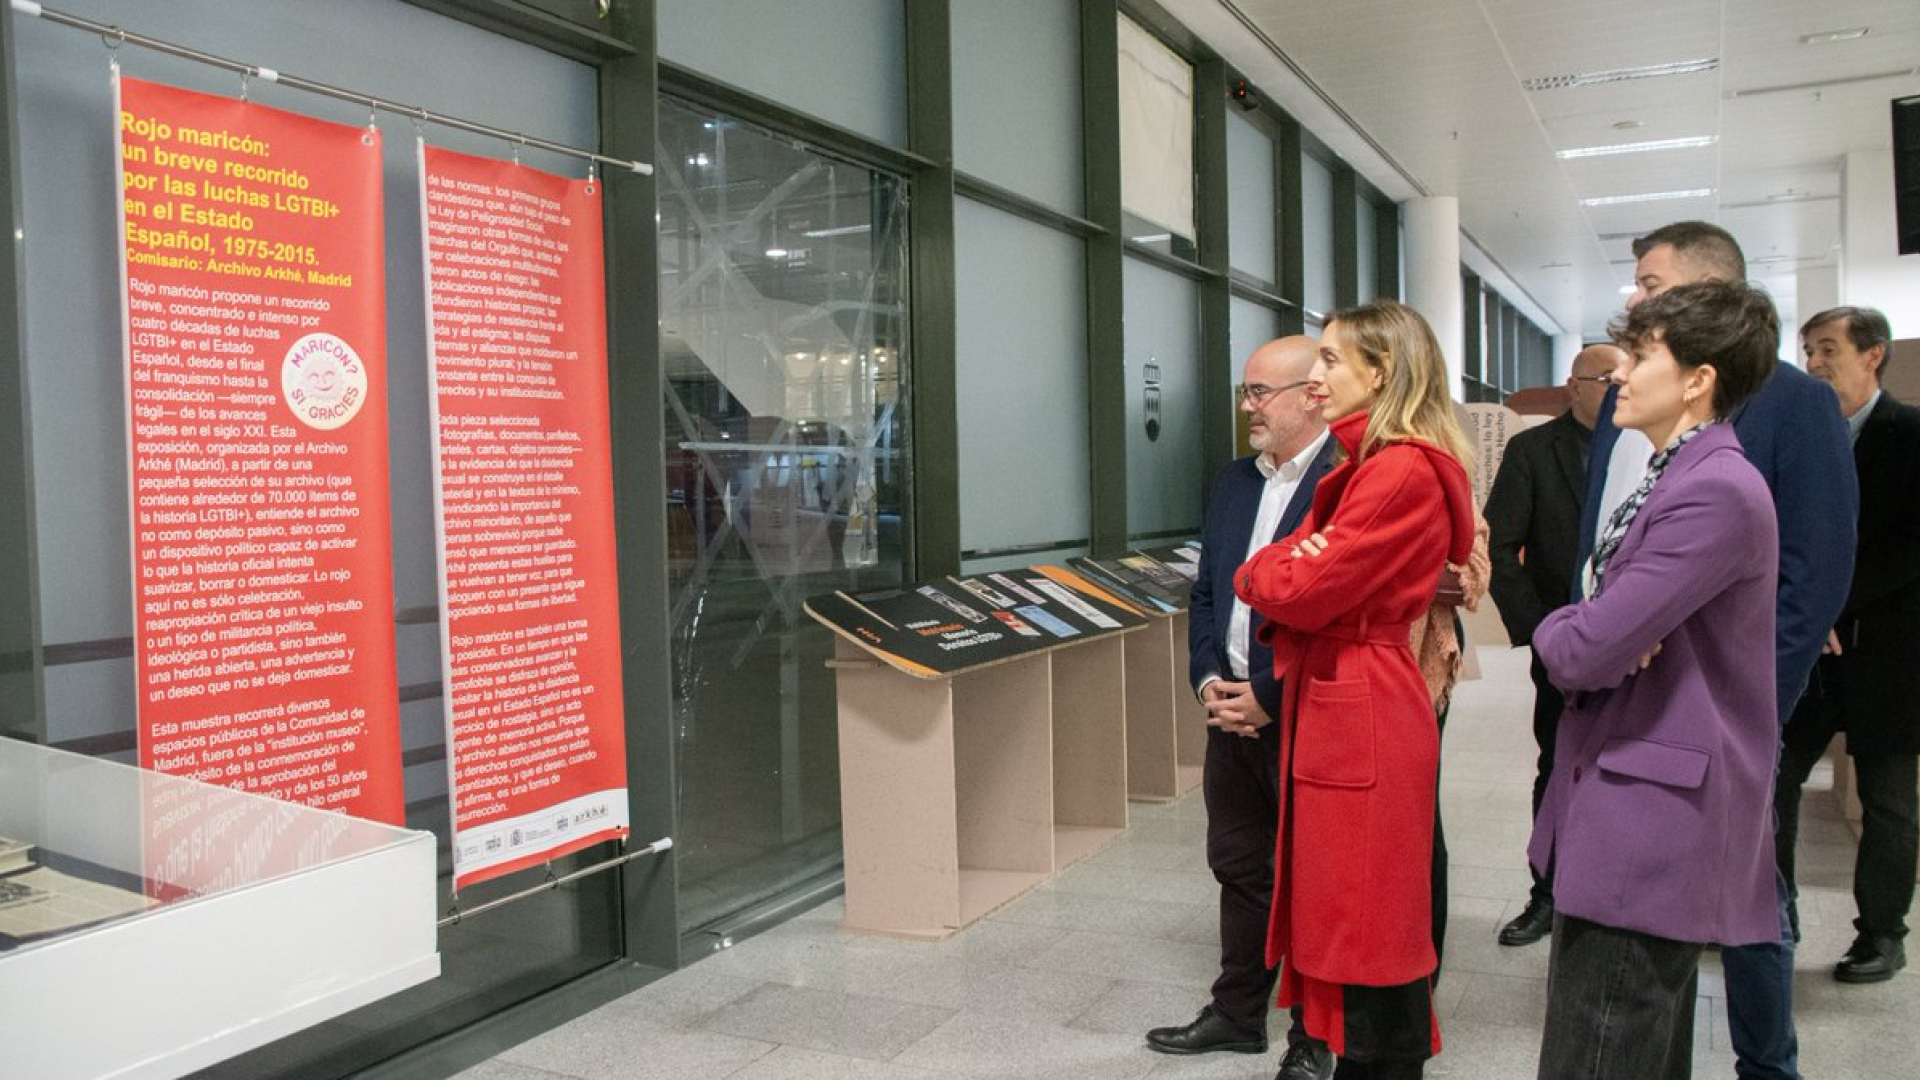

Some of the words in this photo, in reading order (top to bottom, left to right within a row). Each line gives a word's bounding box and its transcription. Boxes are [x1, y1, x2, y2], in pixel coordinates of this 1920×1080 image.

[122, 110, 171, 140] Rojo
[178, 127, 268, 156] maricón:
[122, 144, 146, 162] un
[154, 145, 217, 173] breve
[224, 161, 308, 189] recorrido
[124, 170, 157, 194] por
[164, 173, 196, 196] las
[203, 180, 269, 207] luchas
[275, 192, 338, 217] LGTBI+
[125, 198, 146, 217] en
[152, 201, 172, 220] el
[180, 203, 253, 230] Estado
[126, 222, 215, 254] Español,
[223, 236, 319, 264] 1975-2015.
[127, 248, 202, 270] Comisario:
[206, 258, 261, 277] Archivo
[308, 270, 351, 286] Madrid
[130, 277, 155, 295] Rojo
[158, 284, 208, 299] maricón
[211, 290, 261, 304] propone
[264, 296, 278, 305] un
[281, 297, 329, 310] recorrido
[130, 296, 165, 313] breve,
[169, 303, 245, 320] concentrado
[247, 311, 255, 320] e
[258, 309, 298, 324] intenso
[301, 315, 319, 327] por
[131, 316, 167, 331] cuatro
[170, 318, 221, 335] décadas
[223, 323, 239, 336] de
[242, 325, 280, 339] luchas
[132, 332, 176, 347] LGTBI+
[180, 339, 196, 349] en
[199, 338, 210, 350] el
[213, 338, 253, 354] Estado
[291, 339, 358, 368] MARICON?
[133, 349, 183, 367] Español,
[186, 354, 223, 369] desde
[226, 357, 237, 369] el
[239, 357, 264, 371] final
[134, 368, 150, 381] del
[153, 368, 220, 386] franquismo
[223, 374, 255, 387] hasta
[257, 376, 267, 388] la
[136, 387, 214, 402] consolidación
[308, 386, 359, 420] GRACIES
[179, 405, 195, 418] de
[198, 406, 216, 419] los
[218, 409, 266, 421] avances
[137, 422, 177, 438] legales
[180, 425, 196, 436] en
[199, 424, 210, 436] el
[213, 424, 240, 439] siglo
[270, 424, 295, 437] Esta
[206, 441, 269, 456] organizada
[272, 444, 291, 456] por
[294, 442, 304, 454] el
[306, 441, 346, 453] Archivo
[138, 457, 171, 470] Arkhé
[231, 460, 239, 470] a
[242, 458, 271, 472] partir
[273, 458, 288, 470] de
[291, 460, 312, 469] una
[139, 475, 189, 490] pequeña
[192, 475, 247, 487] selección
[250, 475, 265, 487] de
[267, 476, 281, 486] su
[284, 474, 324, 486] archivo
[326, 474, 351, 487] (que
[139, 493, 189, 506] contiene
[250, 491, 265, 503] de
[268, 490, 306, 503] 70.000
[341, 489, 356, 501] de
[140, 511, 150, 524] la
[153, 510, 196, 523] historia
[255, 506, 304, 520] entiende
[306, 506, 316, 518] el
[319, 505, 359, 517] archivo
[142, 531, 155, 541] no
[158, 529, 191, 541] como
[194, 525, 244, 541] depósito
[290, 523, 313, 535] sino
[315, 523, 344, 533] como
[159, 543, 222, 560] dispositivo
[268, 541, 301, 554] capaz
[321, 537, 356, 549] activar
[156, 565, 178, 579] que
[196, 559, 238, 573] historia
[276, 555, 313, 567] intenta
[199, 578, 235, 591] borrar
[330, 568, 350, 582] rojo
[146, 611, 226, 631] reapropiación
[300, 602, 324, 616] viejo
[326, 599, 362, 611] insulto
[157, 636, 172, 647] un
[175, 632, 197, 647] tipo
[280, 637, 302, 649] sino
[149, 671, 170, 683] una
[173, 664, 211, 679] herida
[260, 657, 282, 668] una
[167, 684, 205, 699] deseo
[207, 680, 230, 694] que
[233, 678, 249, 689] no
[267, 670, 290, 685] deja
[152, 722, 178, 736] Esta
[181, 714, 231, 731] muestra
[209, 727, 258, 747] públicos
[289, 709, 348, 729] Comunidad
[201, 748, 234, 762] fuera
